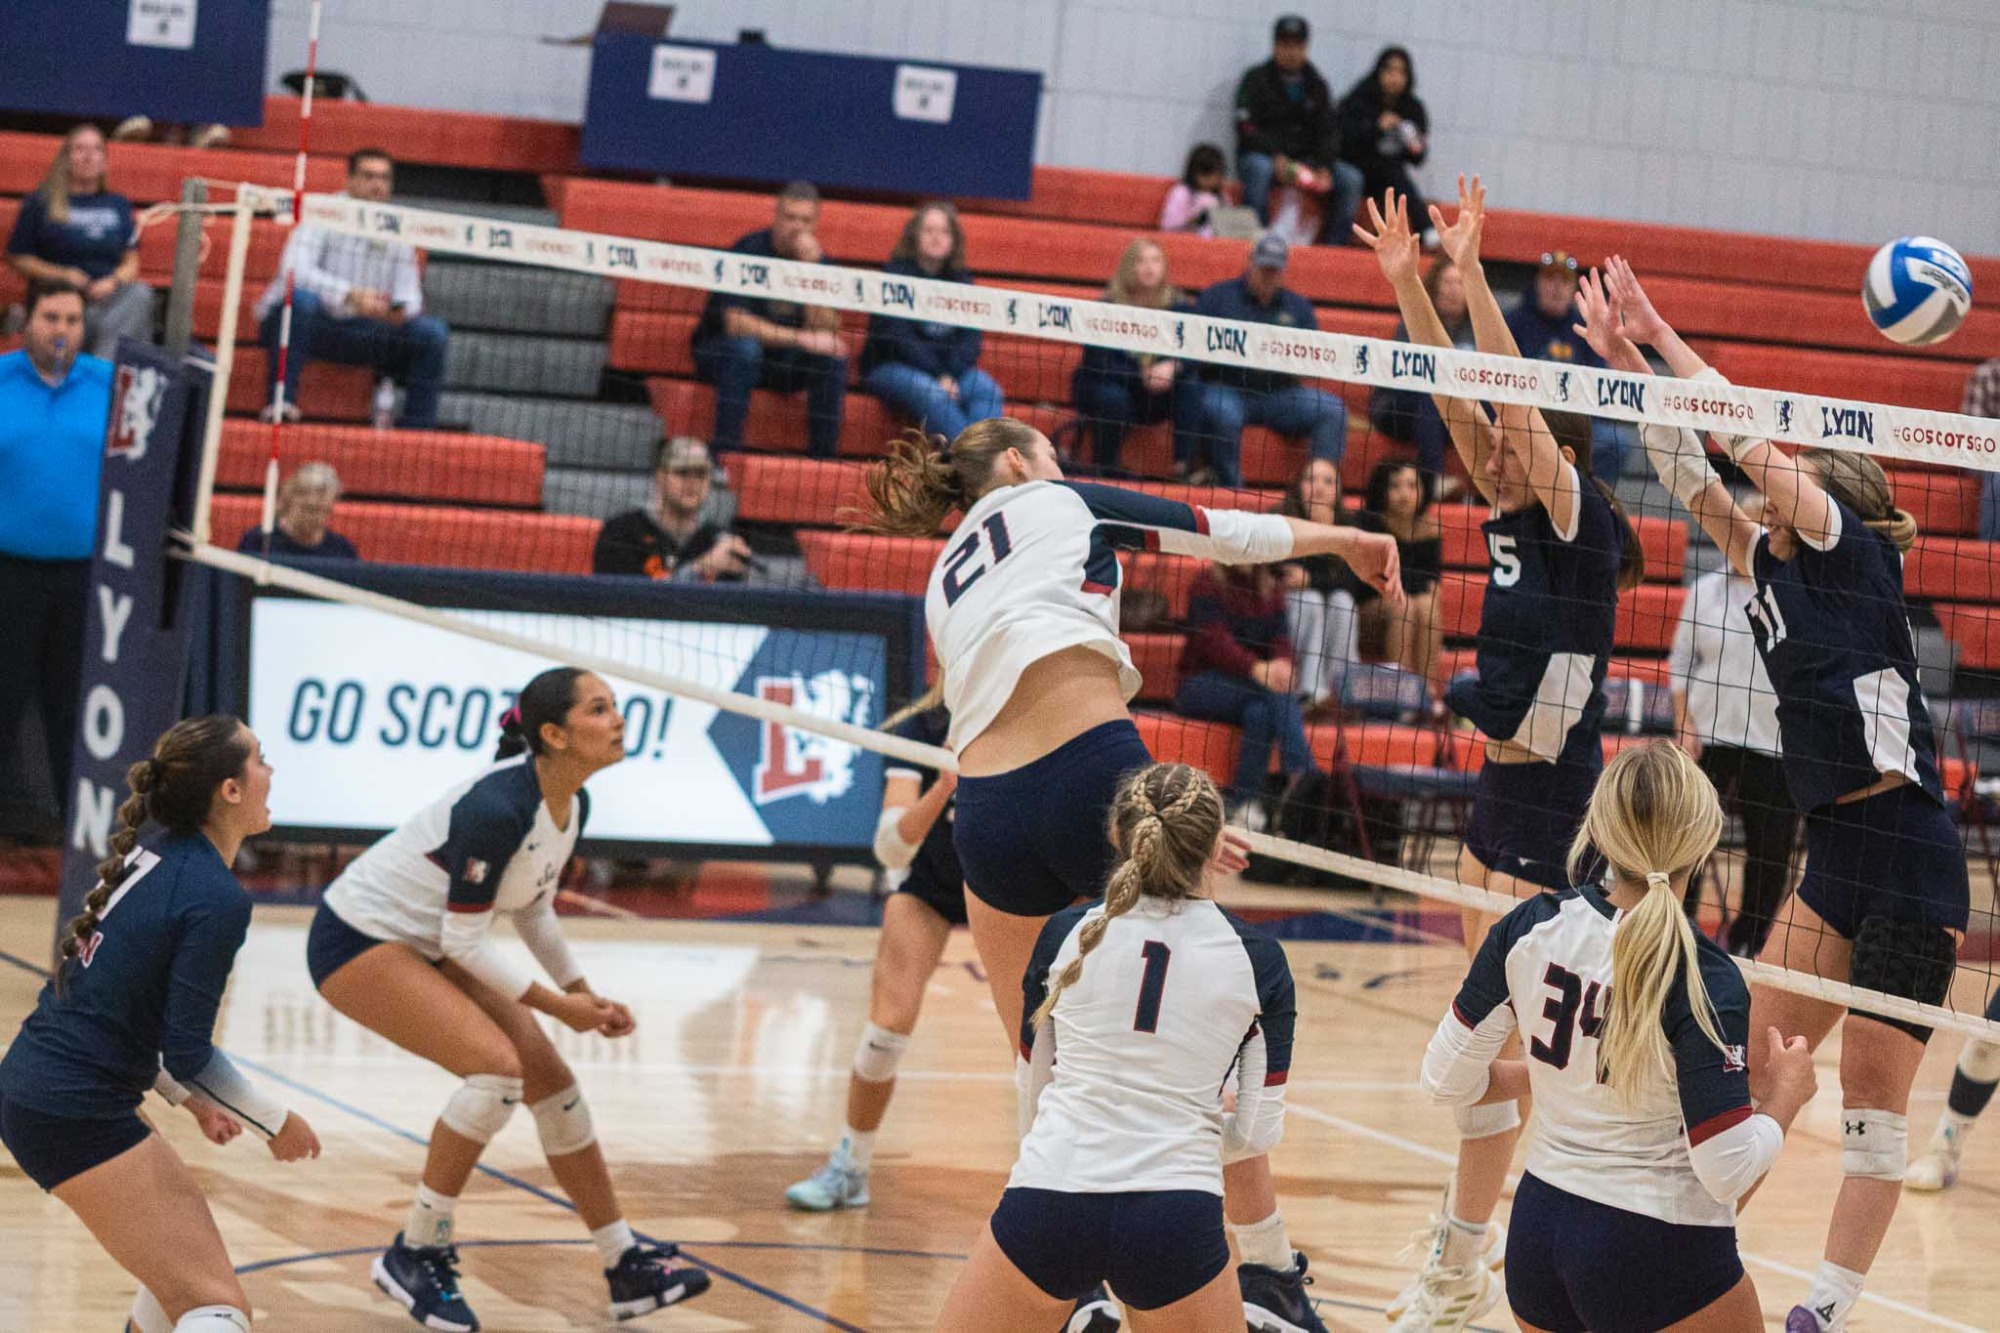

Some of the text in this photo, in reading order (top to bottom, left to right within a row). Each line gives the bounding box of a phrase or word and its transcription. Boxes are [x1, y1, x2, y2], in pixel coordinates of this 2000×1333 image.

[1039, 302, 1073, 332] LYON
[1207, 325, 1247, 356] LYON
[1260, 340, 1337, 363] #GOSCOTSGO
[1392, 350, 1436, 384] LYON
[1453, 367, 1538, 391] #GOSCOTSGO
[1597, 377, 1646, 413] LYON
[1664, 395, 1755, 420] #GOSCOTSGO
[1820, 406, 1874, 445] LYON
[1894, 427, 1996, 453] #GOSCOTSGO
[942, 510, 1013, 609] 21
[1748, 583, 1788, 654] 11
[73, 489, 134, 859] LYON
[288, 678, 366, 745] GO
[379, 682, 520, 752] SCO
[1132, 939, 1172, 1035] 1
